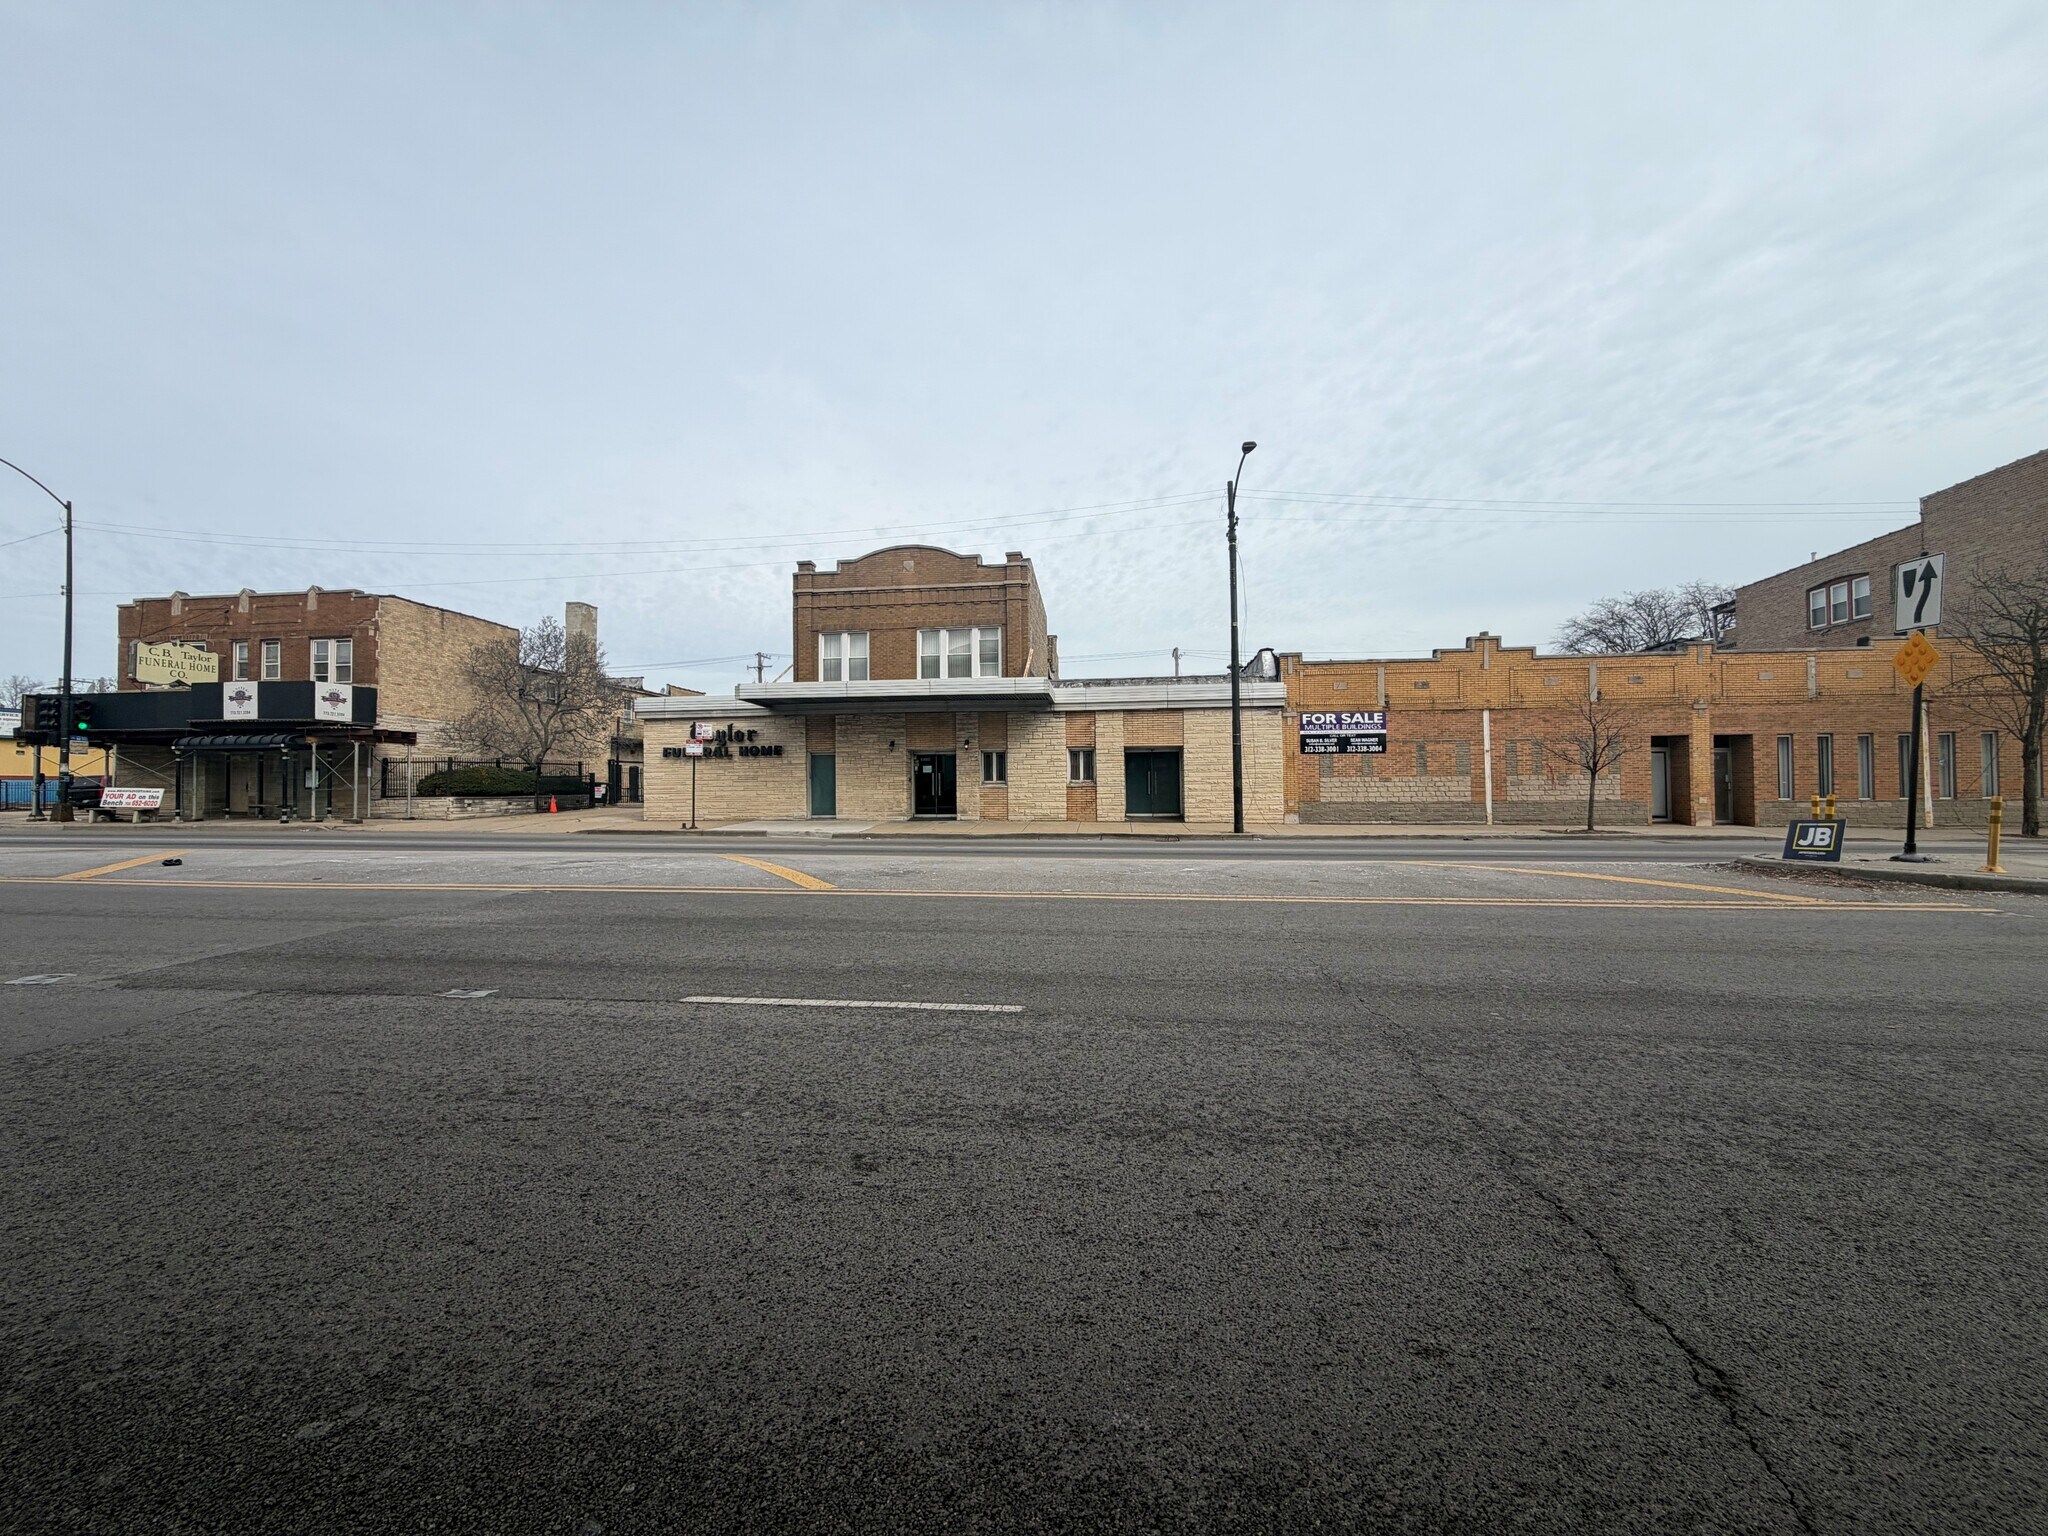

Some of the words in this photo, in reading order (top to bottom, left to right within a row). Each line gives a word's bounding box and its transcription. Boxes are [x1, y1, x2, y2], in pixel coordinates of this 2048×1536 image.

[181, 651, 212, 663] Taylor
[138, 656, 186, 670] FUNERAL
[189, 662, 217, 674] HOME
[169, 669, 188, 679] CO.
[1302, 713, 1337, 724] FOR
[1341, 712, 1383, 724] SALE
[663, 747, 733, 758] FURAL
[739, 745, 783, 756] HOME
[1797, 827, 1832, 846] JB
